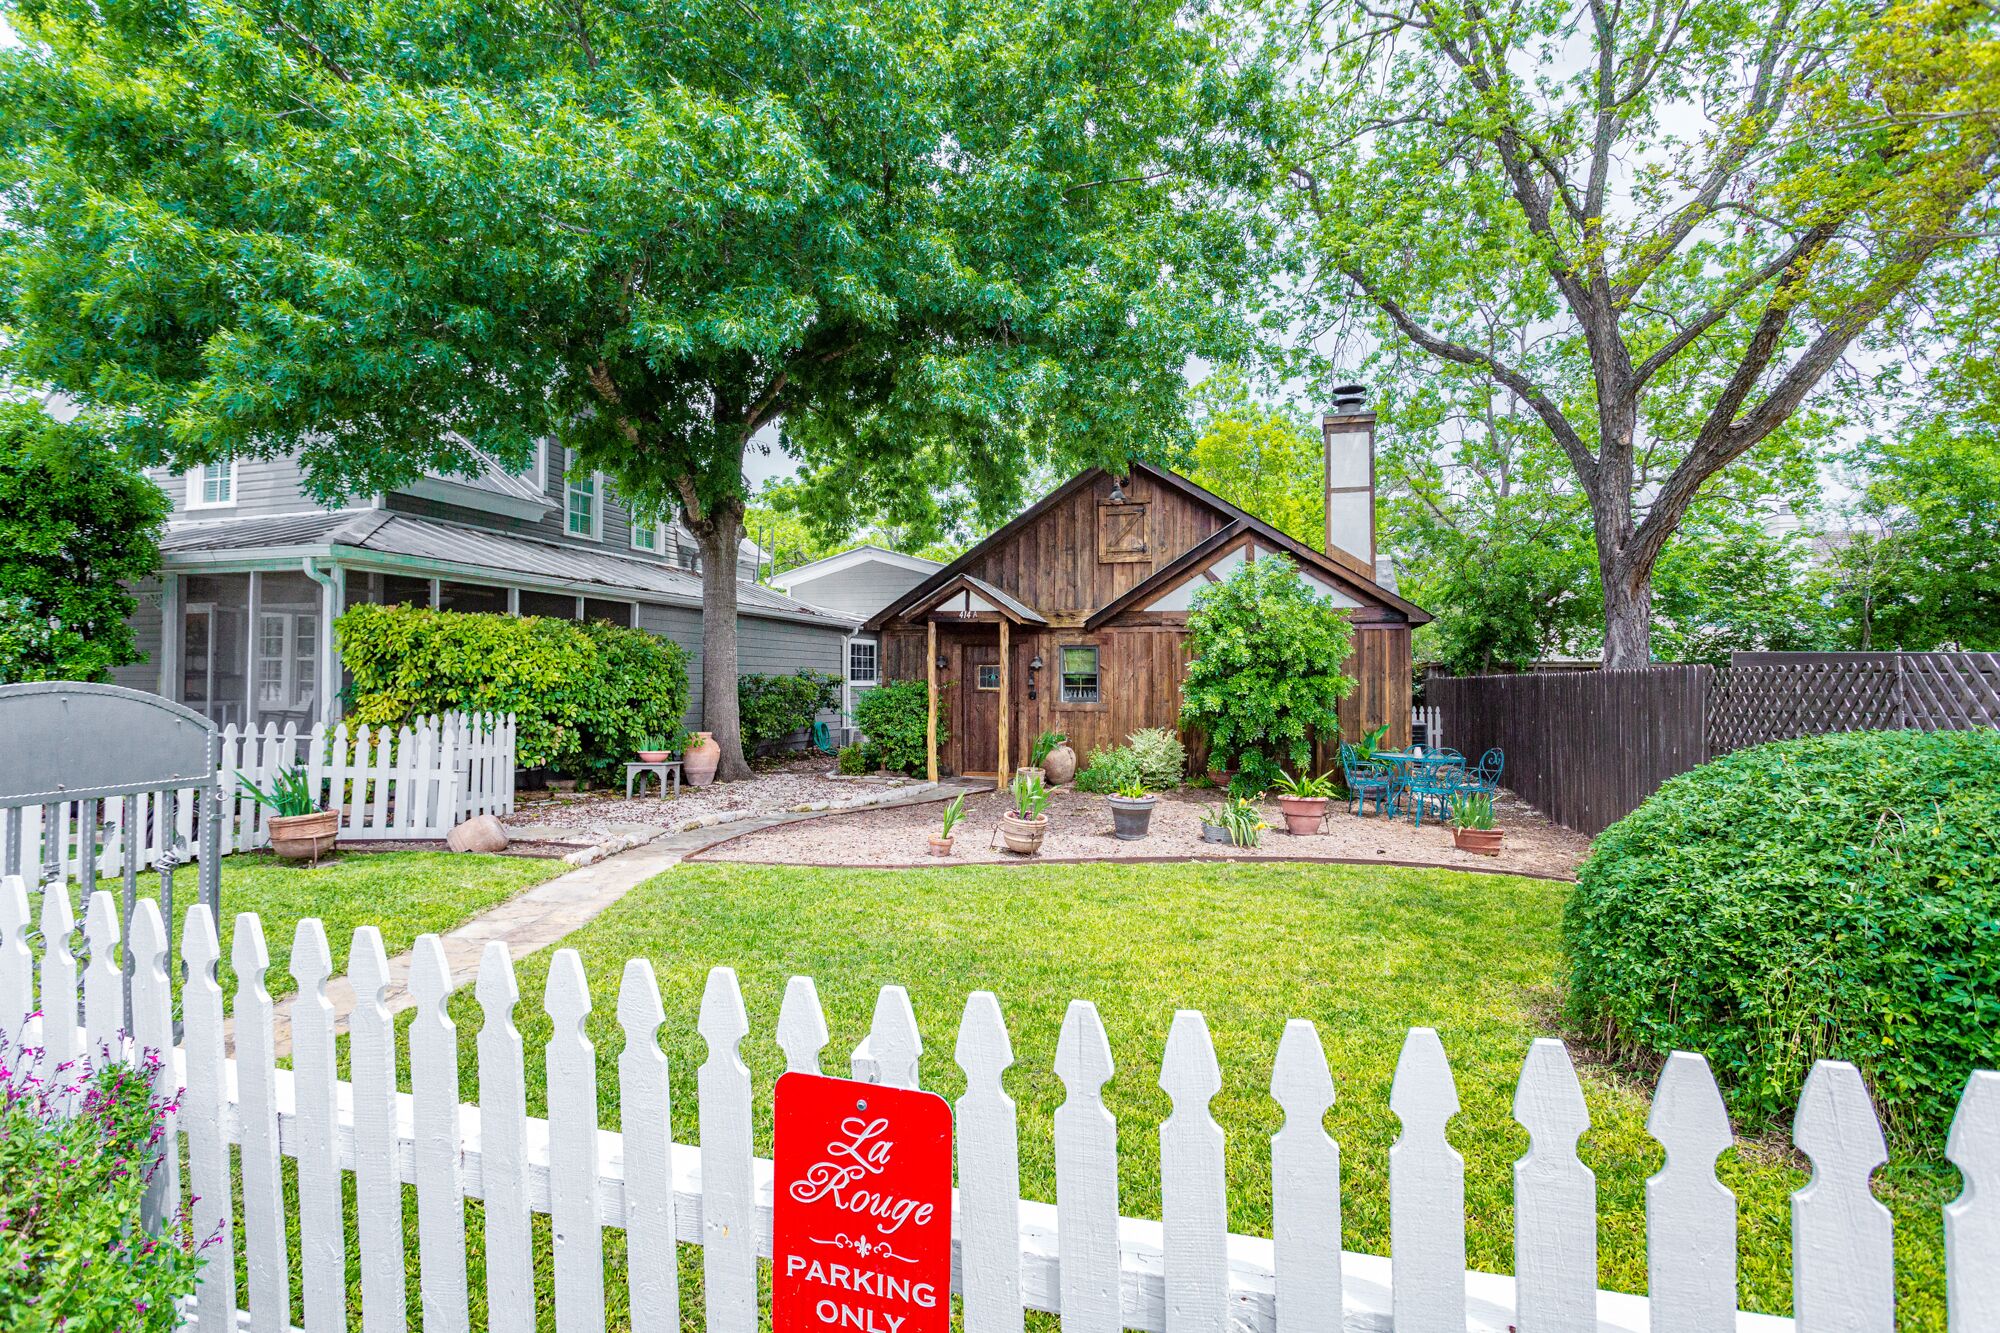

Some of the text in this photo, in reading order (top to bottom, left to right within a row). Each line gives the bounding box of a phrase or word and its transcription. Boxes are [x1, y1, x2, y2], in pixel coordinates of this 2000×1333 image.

[959, 610, 971, 619] 414
[827, 1116, 894, 1174] La
[789, 1161, 934, 1234] Rouge
[786, 1254, 937, 1308] PARKING
[816, 1299, 906, 1333] ONLY
